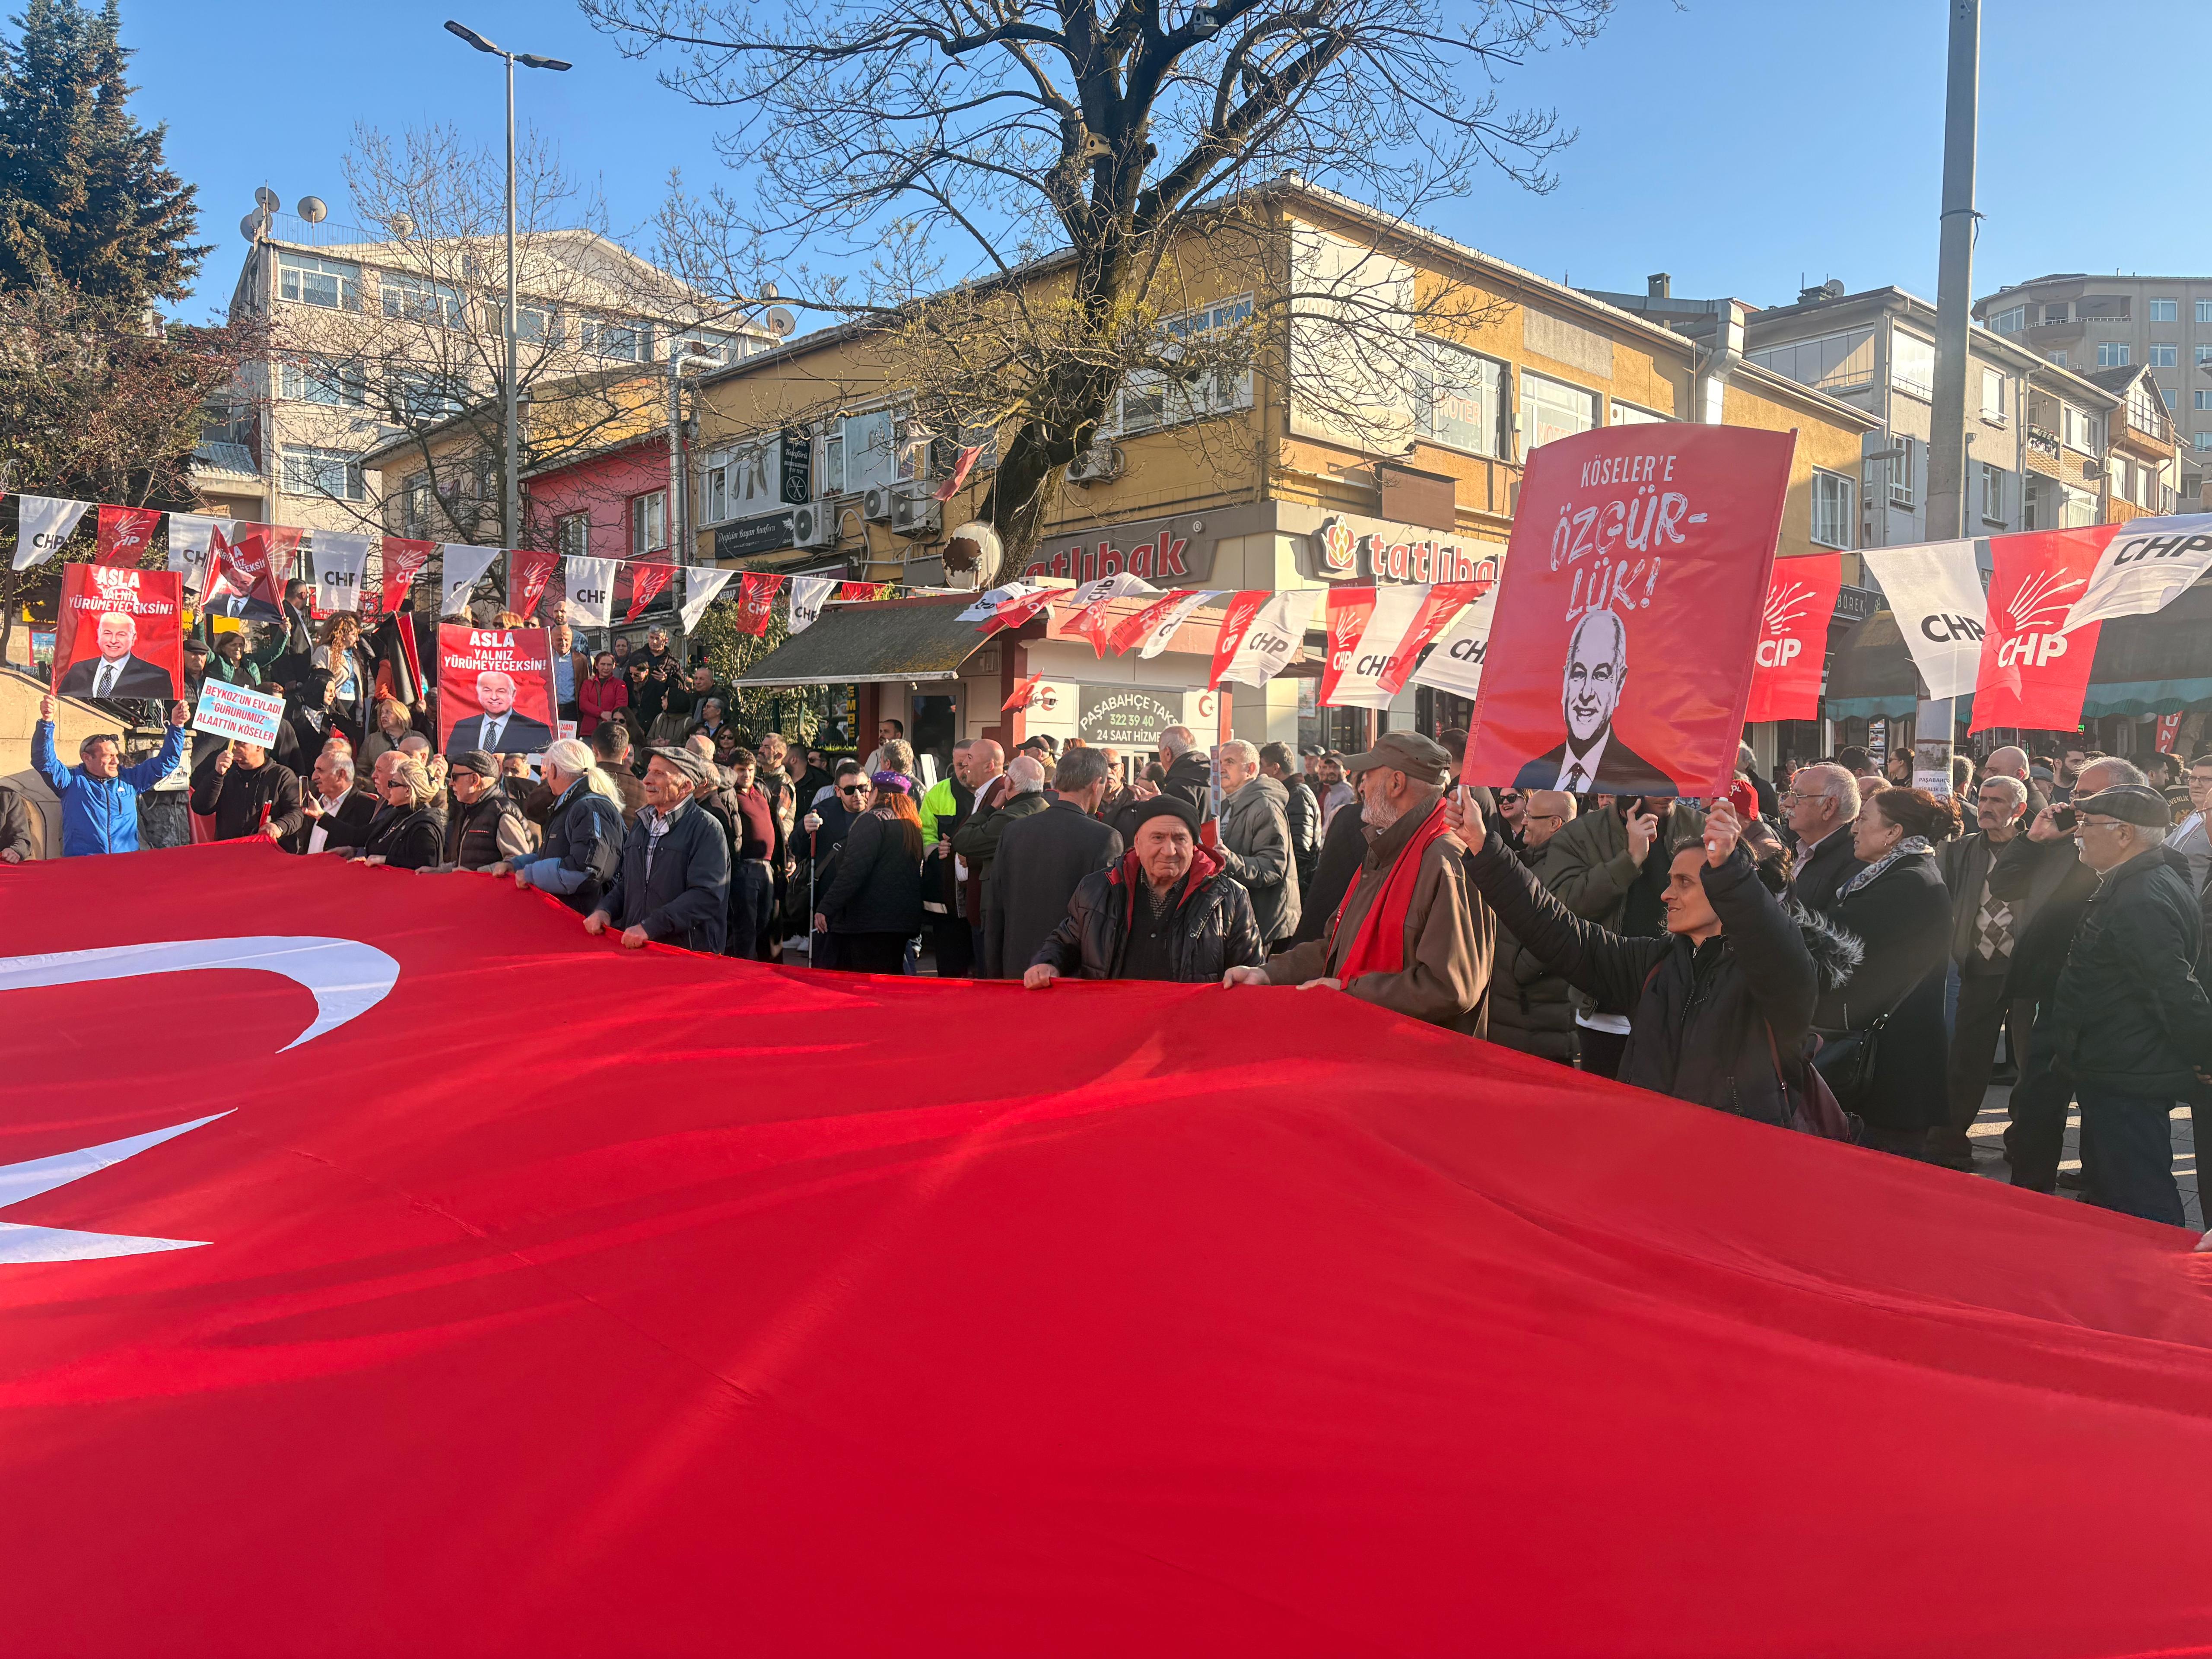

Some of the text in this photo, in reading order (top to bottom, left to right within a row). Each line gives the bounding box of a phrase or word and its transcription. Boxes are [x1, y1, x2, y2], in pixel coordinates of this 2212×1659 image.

[1581, 454, 1676, 488] KÖSELER'E
[1551, 484, 1708, 572] ÖZGÜR-
[32, 533, 65, 550] CHP
[2113, 535, 2212, 566] CHP
[183, 549, 207, 567] CH
[1024, 531, 1188, 582] atlıbak
[97, 566, 140, 588] ASLA
[1566, 556, 1661, 622] LÜK!
[1837, 594, 1864, 613] BÖREK
[469, 631, 515, 648] ASLA
[1249, 632, 1289, 655] CHP
[1998, 632, 2068, 668] CHP
[444, 654, 547, 671] YÜRÜMEYECEKSİN!
[474, 648, 513, 661] YALNIZ
[1450, 639, 1488, 664] CH
[205, 685, 281, 715] BEYKOZ'UN EVLADI
[1080, 694, 1150, 731] PAŞABAHÇE
[1110, 713, 1154, 727] 322 39 40
[197, 712, 274, 742] ALAATTİN KÖSELER
[1096, 728, 1162, 742] 24 SAAT HİZME
[2168, 794, 2190, 807] ÜVENLİK
